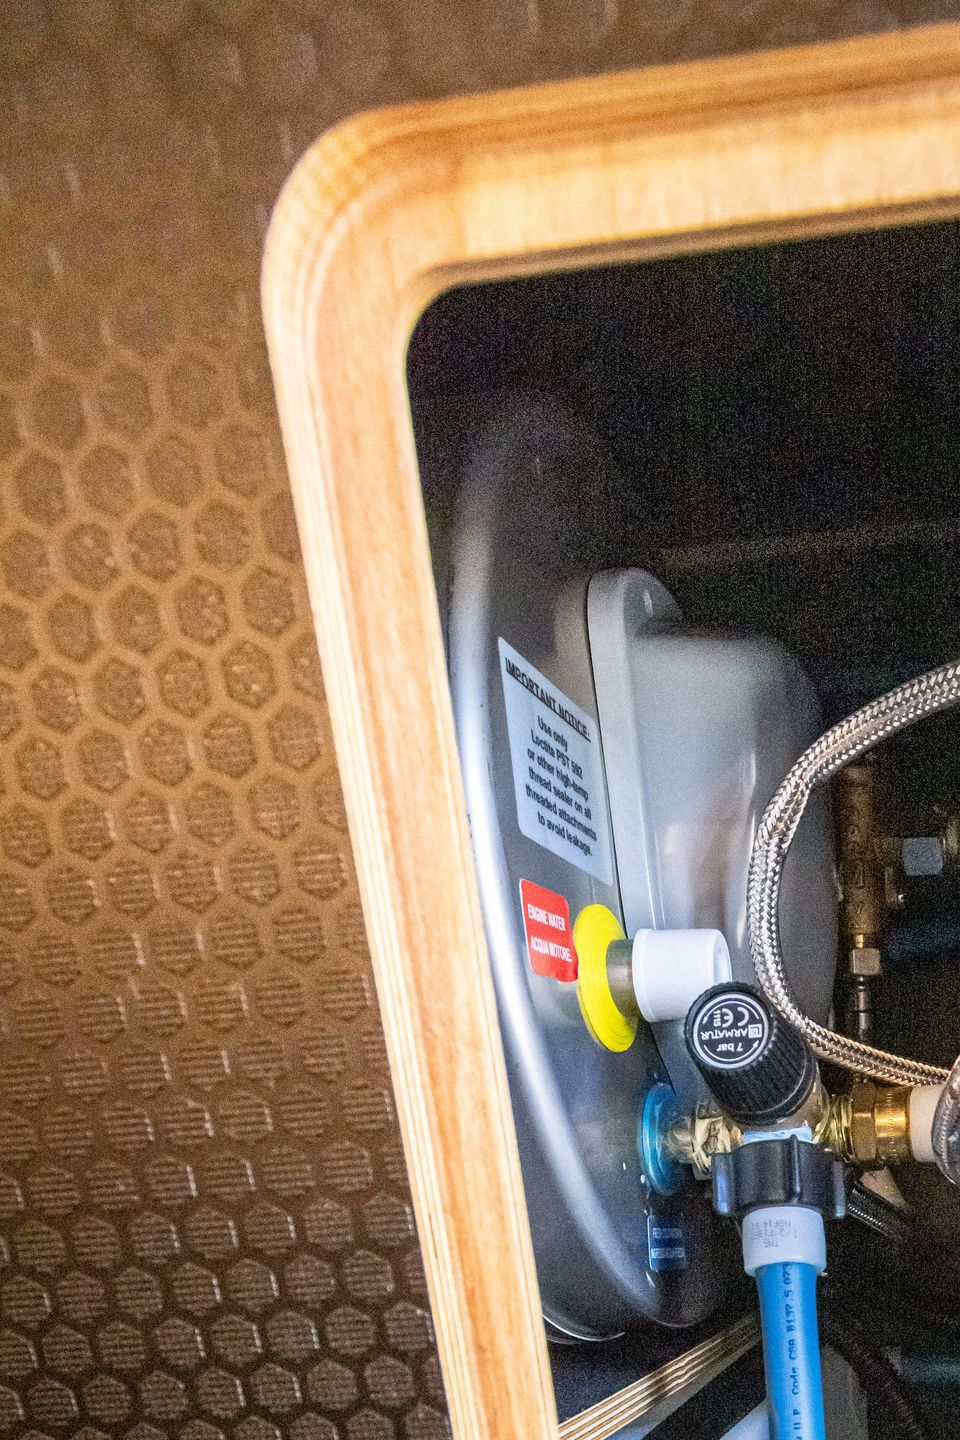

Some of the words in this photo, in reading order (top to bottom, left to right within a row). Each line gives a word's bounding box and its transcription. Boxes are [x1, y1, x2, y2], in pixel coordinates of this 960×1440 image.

[505, 657, 556, 712] IMPORTANT
[531, 728, 555, 758] Loctite
[556, 749, 570, 769] PST
[537, 715, 552, 737] Use
[553, 731, 568, 752] only
[527, 748, 535, 761] or
[537, 754, 555, 776] other
[556, 766, 589, 803] high-temp
[528, 766, 552, 792] thread
[553, 785, 573, 807] sealer
[574, 800, 583, 813] on
[584, 807, 592, 821] all
[525, 783, 558, 815] threaded
[558, 808, 597, 841] attachments
[537, 810, 546, 826] to
[546, 819, 565, 839] avoid
[527, 903, 548, 926] ENGINE
[548, 912, 567, 932] WATER
[530, 936, 549, 955] ACQUA
[700, 1028, 748, 1040] ARMATUR
[716, 1043, 735, 1052] bar
[737, 1042, 744, 1051] 7
